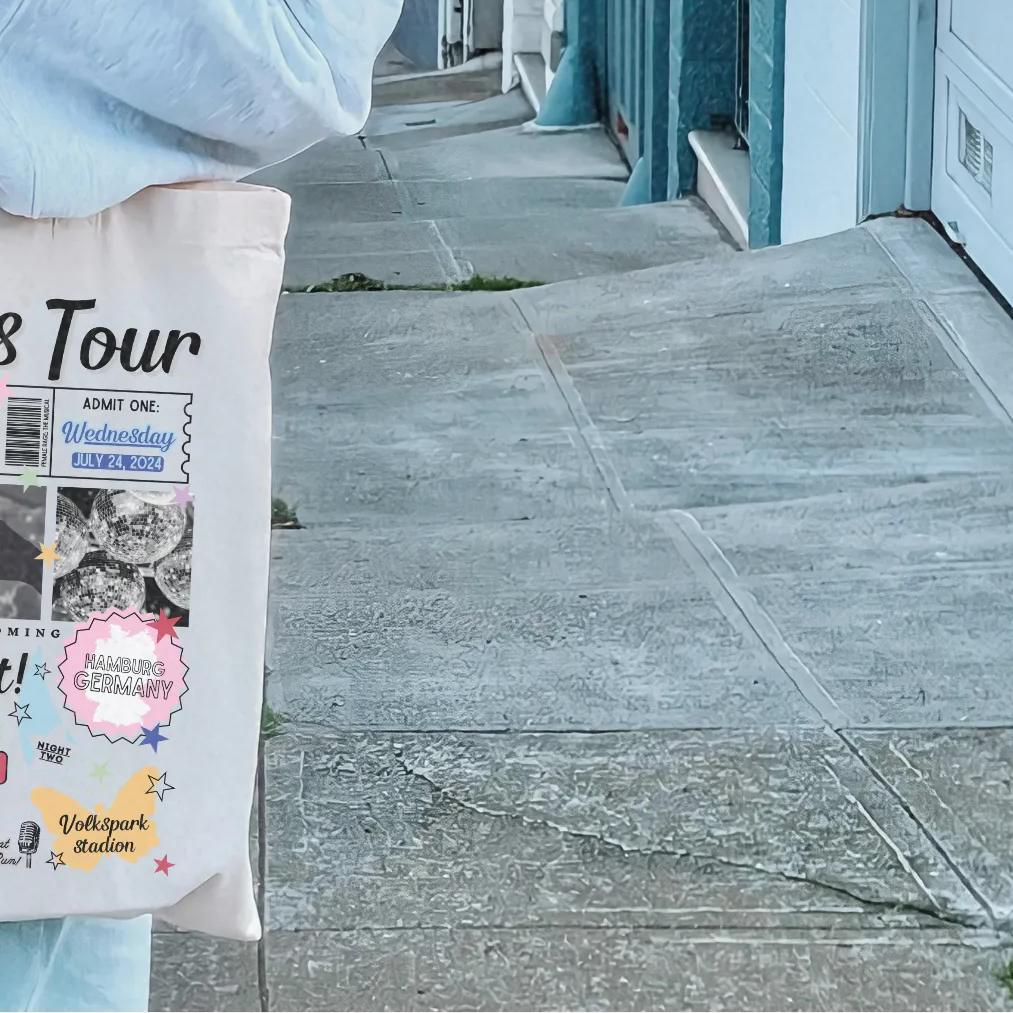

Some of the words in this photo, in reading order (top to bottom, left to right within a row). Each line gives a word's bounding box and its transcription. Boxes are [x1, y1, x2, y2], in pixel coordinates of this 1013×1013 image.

[45, 298, 202, 381] Tour
[83, 397, 125, 412] ADMIT
[129, 399, 160, 413] ONE:
[61, 420, 177, 453] Wednesday
[73, 453, 104, 468] JULY
[108, 454, 126, 471] 24,
[130, 455, 162, 471] 2024
[84, 653, 166, 677] HAMBURG
[73, 670, 174, 700] GERMANY
[36, 740, 71, 757] NIGHT
[39, 751, 64, 765] TWO
[59, 813, 149, 838] Volkspark
[73, 835, 137, 854] stadion
